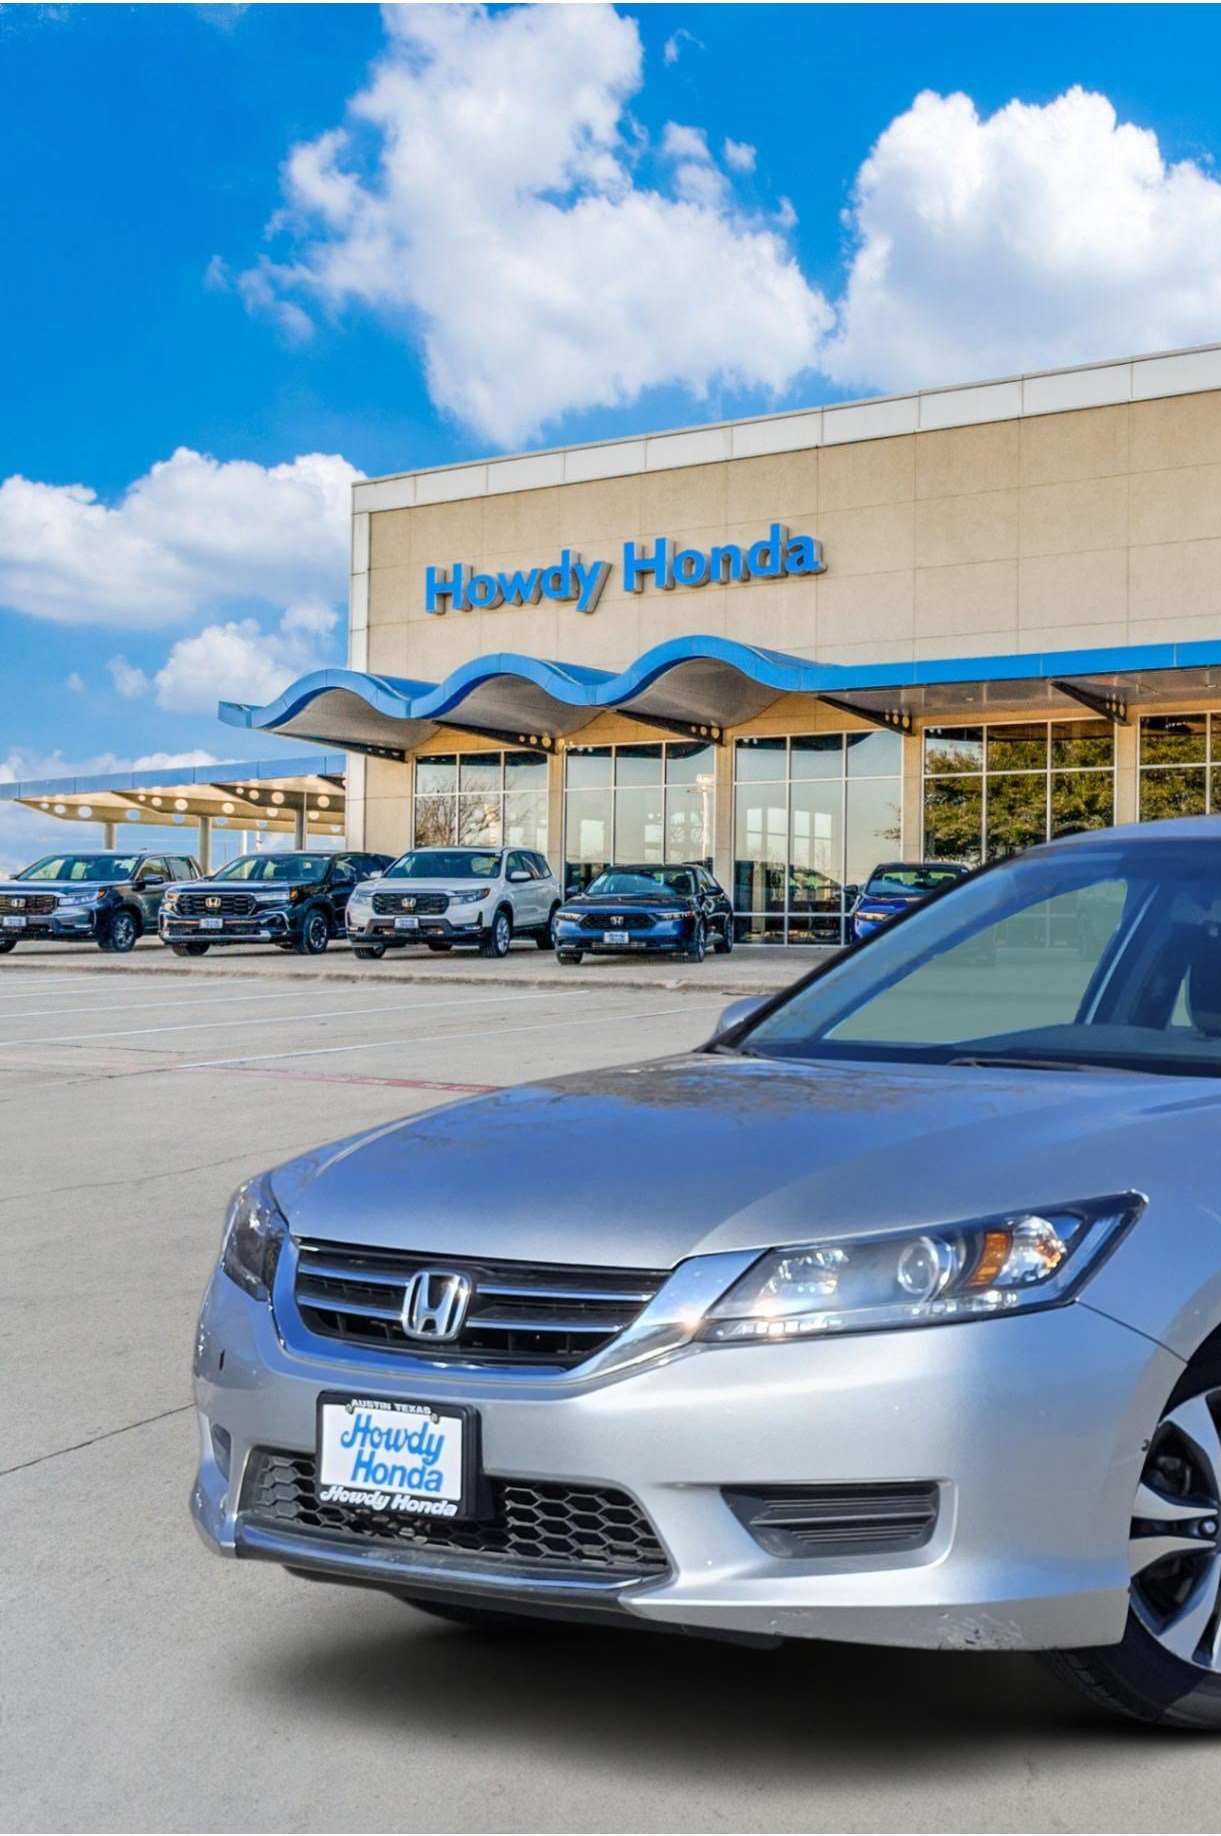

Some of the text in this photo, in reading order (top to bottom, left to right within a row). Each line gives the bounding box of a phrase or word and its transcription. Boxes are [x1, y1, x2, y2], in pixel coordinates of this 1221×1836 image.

[425, 523, 827, 615] Howdy Honda
[351, 1399, 431, 1415] AUSTIN TEXAS
[340, 1413, 445, 1466] Howdy
[351, 1449, 444, 1492] Honda
[320, 1485, 458, 1517] Howdy Honda
